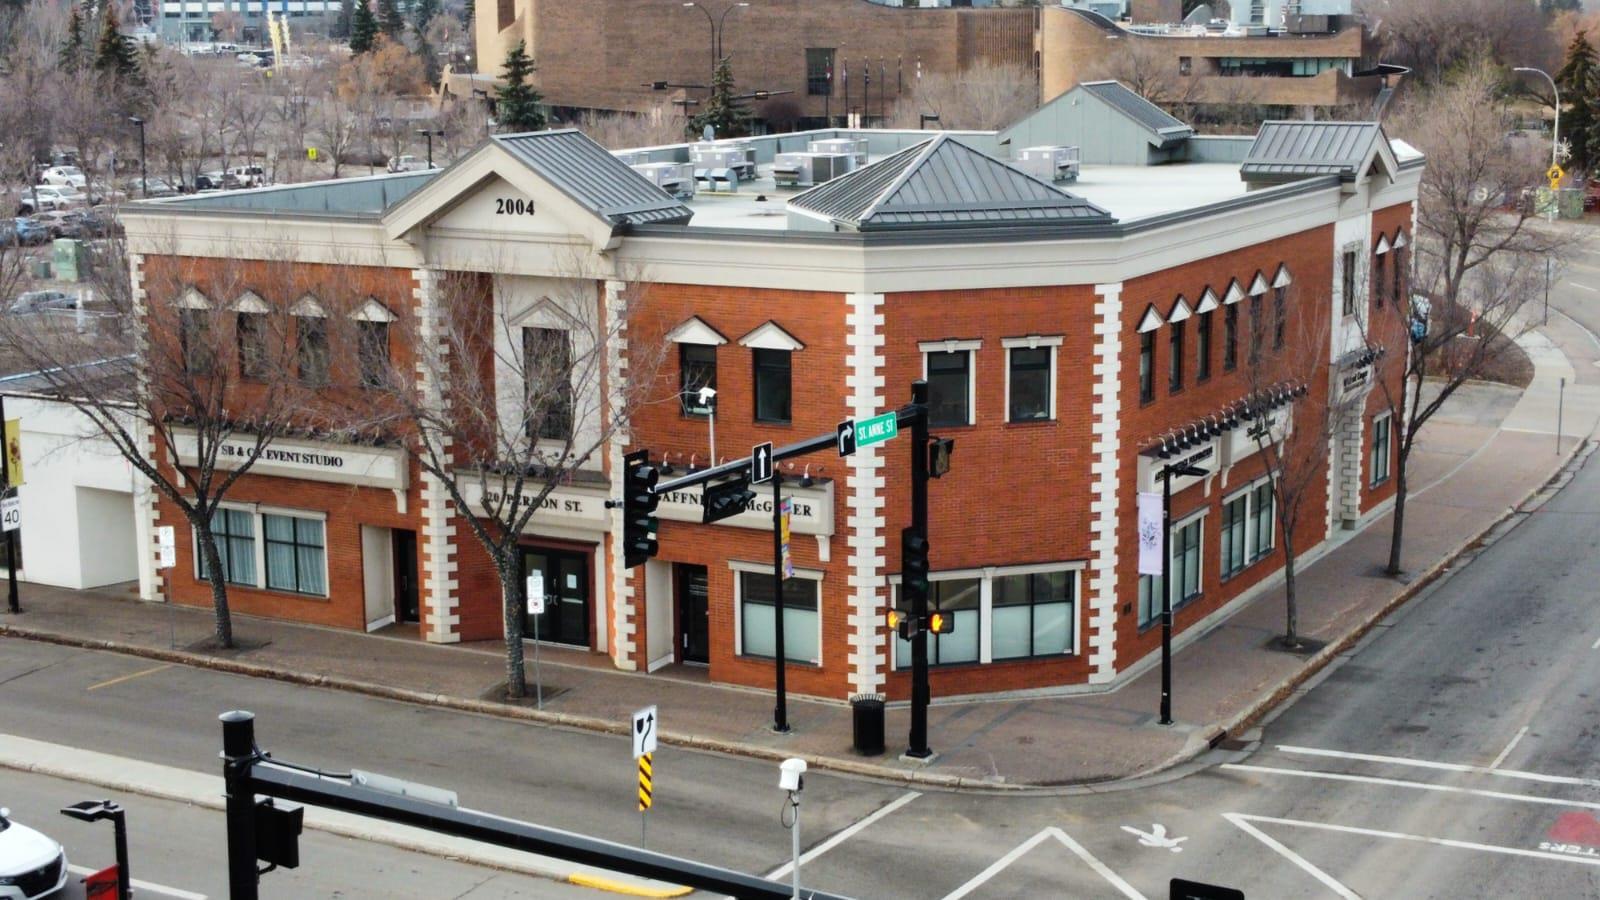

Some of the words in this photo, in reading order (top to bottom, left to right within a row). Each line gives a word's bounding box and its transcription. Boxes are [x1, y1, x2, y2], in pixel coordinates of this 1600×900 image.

[495, 198, 535, 216] 2004
[886, 418, 894, 433] ST
[237, 446, 244, 457] &
[266, 449, 302, 463] EVENT
[302, 453, 343, 467] STUDIO
[565, 500, 583, 512] ST.
[4, 509, 20, 525] 40
